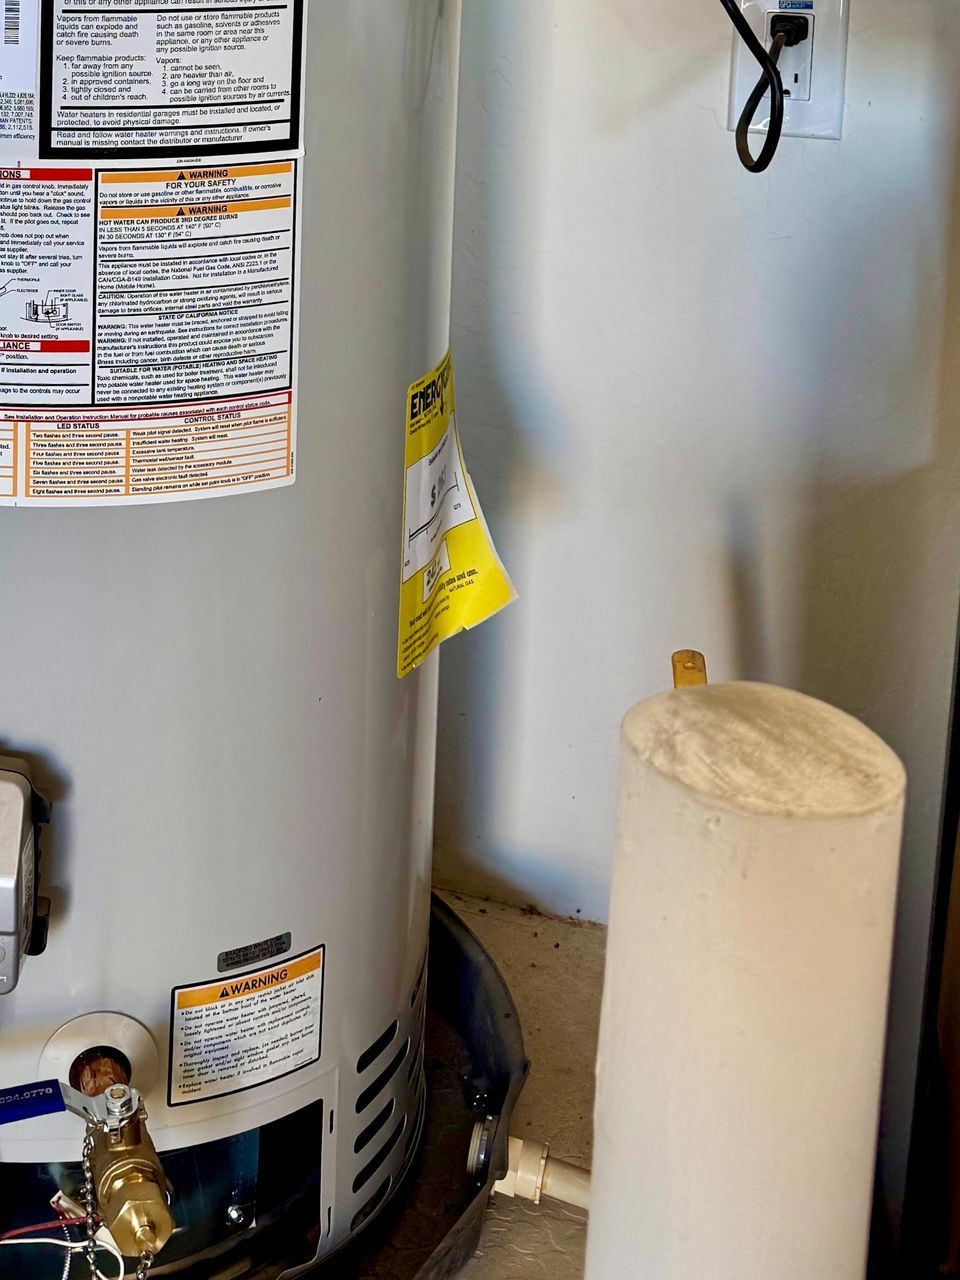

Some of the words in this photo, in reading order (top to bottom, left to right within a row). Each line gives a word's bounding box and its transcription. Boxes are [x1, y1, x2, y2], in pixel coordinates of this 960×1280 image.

[190, 169, 229, 180] WARNING
[166, 181, 181, 190] FOR
[182, 180, 206, 189] YOUR
[208, 179, 236, 187] SAFETY
[189, 205, 228, 215] WARNING
[113, 218, 135, 226] WATER
[136, 217, 150, 225] CAN
[150, 216, 180, 224] PRODUCE
[181, 215, 193, 223] 3RD
[194, 214, 218, 222] DEGREE
[219, 213, 238, 221] BURNS
[184, 416, 215, 425] CONTROL
[217, 413, 241, 421] STATUS
[230, 970, 288, 996] WARNING
